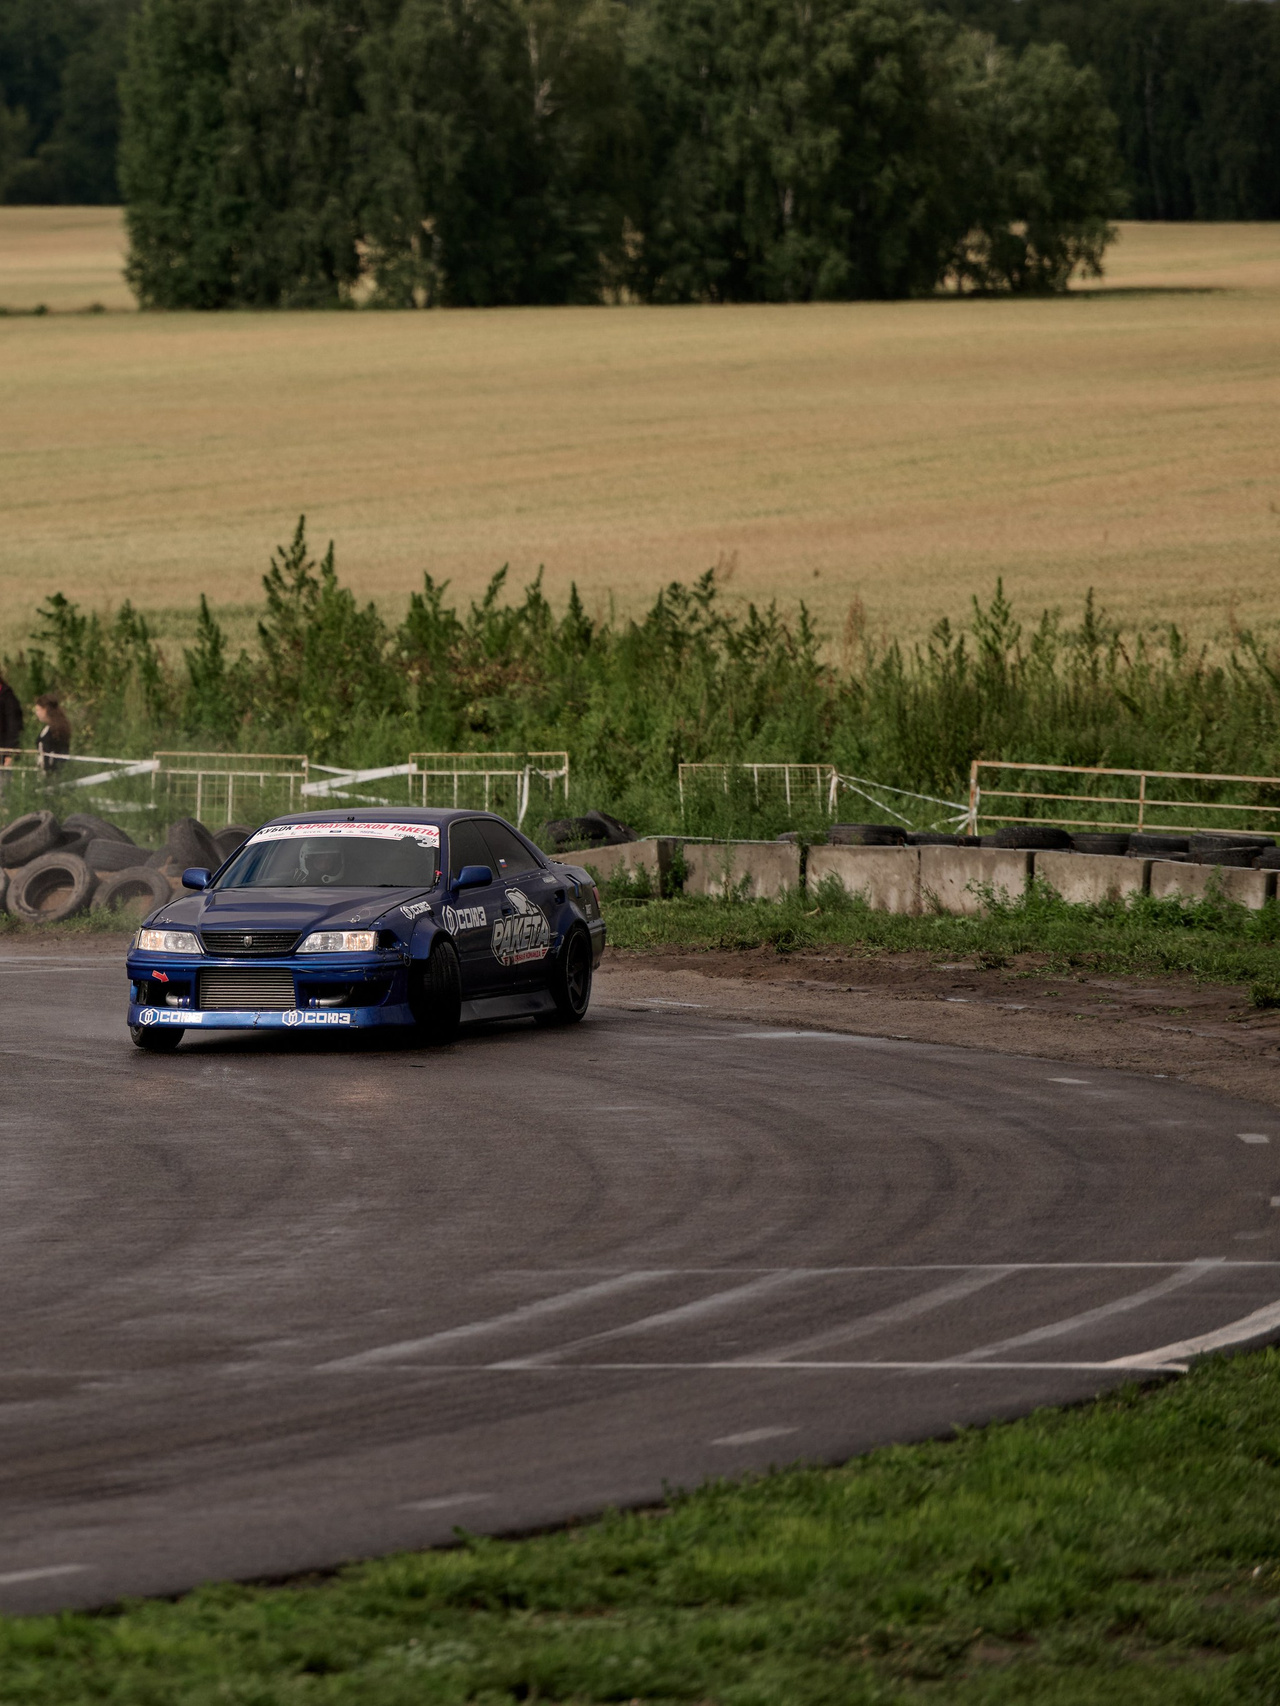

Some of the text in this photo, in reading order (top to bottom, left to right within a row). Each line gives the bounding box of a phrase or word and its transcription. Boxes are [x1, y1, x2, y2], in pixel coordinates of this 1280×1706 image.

[257, 825, 294, 836] КУБОК
[295, 823, 389, 831] БАРНАУЛЬСКОЙ
[390, 825, 439, 837] РАКЕТЫ
[456, 906, 487, 930] СОЮЗ
[492, 914, 550, 957] РАКЕТА
[304, 1012, 351, 1024] СОЮЗ
